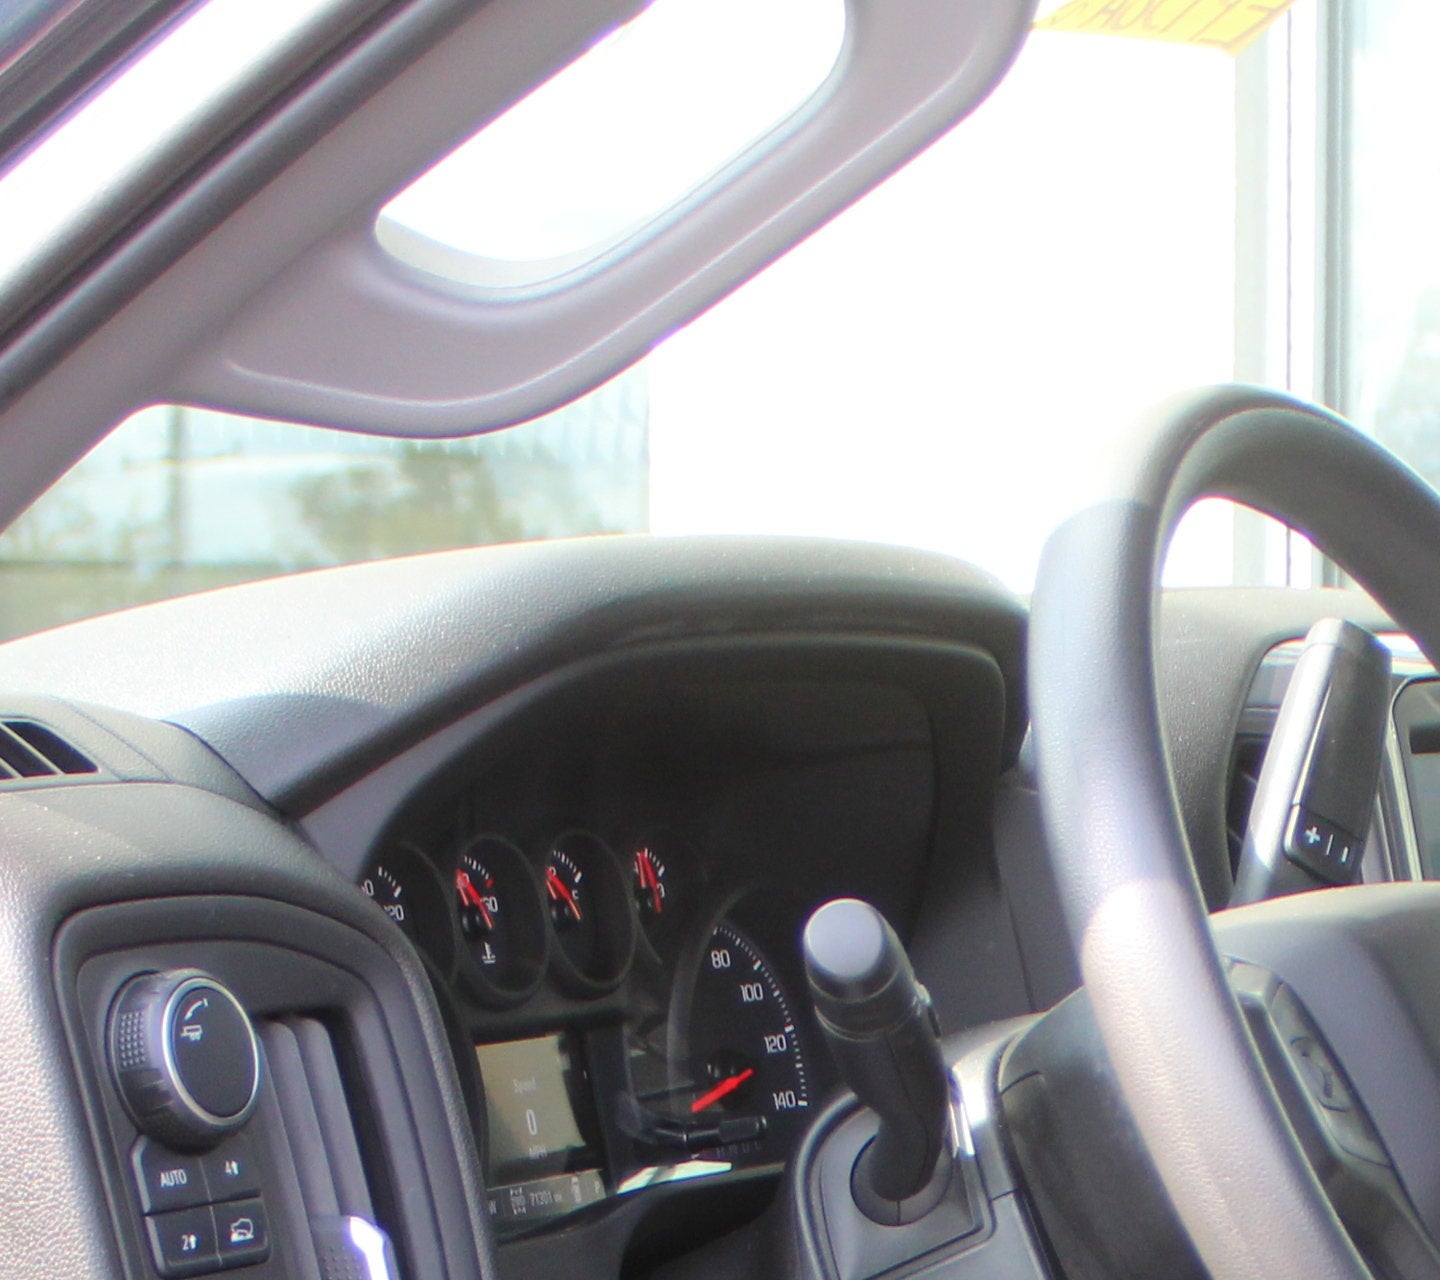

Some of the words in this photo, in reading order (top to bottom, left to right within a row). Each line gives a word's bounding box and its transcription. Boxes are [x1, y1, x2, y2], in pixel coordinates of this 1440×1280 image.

[711, 950, 731, 968] 80
[740, 982, 763, 1002] 100
[764, 1034, 787, 1053] 120
[773, 1090, 796, 1110] 140
[526, 1109, 537, 1136] 0
[160, 1168, 187, 1187] AUTO
